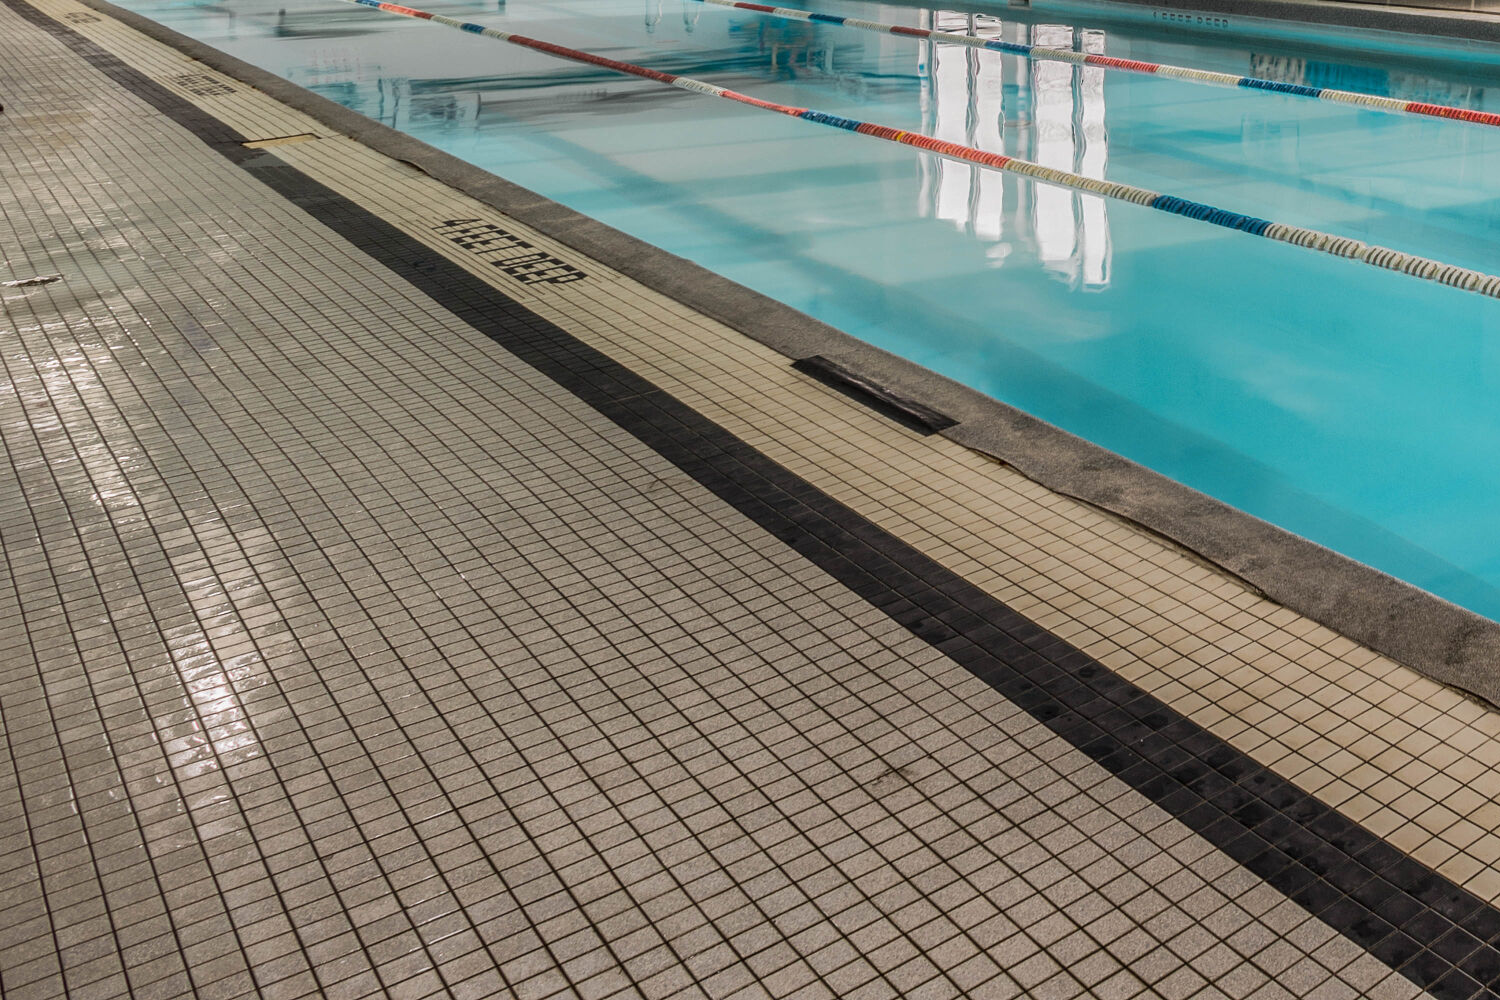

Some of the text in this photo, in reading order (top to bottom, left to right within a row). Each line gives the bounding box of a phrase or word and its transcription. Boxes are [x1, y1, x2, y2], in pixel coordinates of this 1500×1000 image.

[431, 218, 589, 286] 4 FEET DEEP
